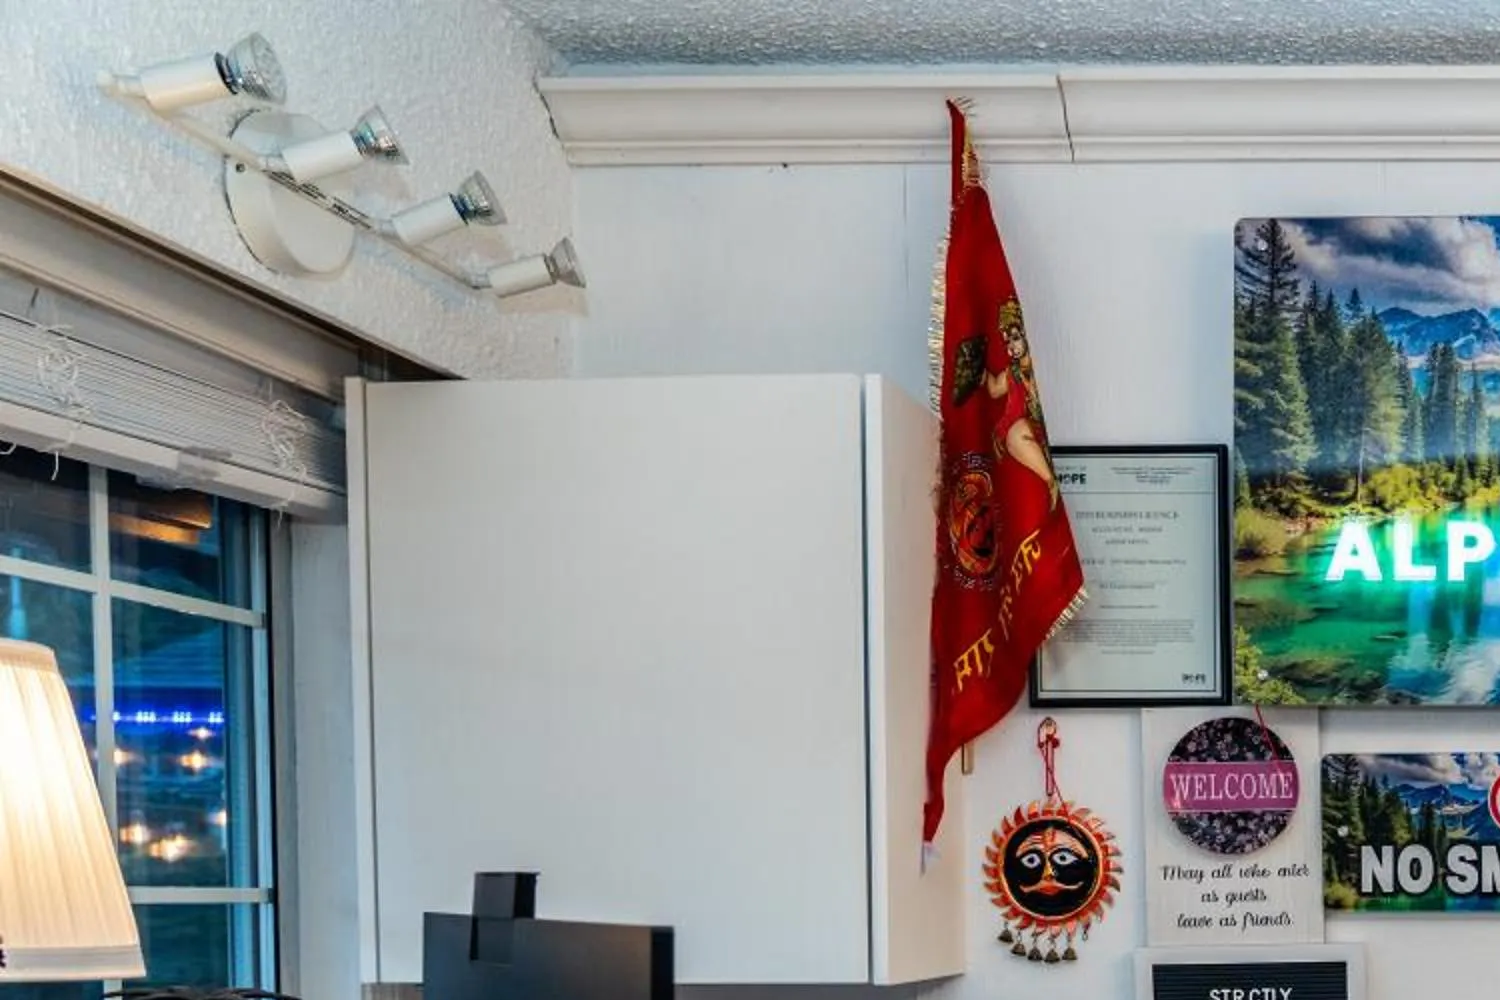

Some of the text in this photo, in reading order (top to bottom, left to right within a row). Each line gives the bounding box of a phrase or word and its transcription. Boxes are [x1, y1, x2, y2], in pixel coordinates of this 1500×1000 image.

[1169, 772, 1294, 801] WELCOME
[1160, 864, 1309, 883] May all who enter
[1361, 843, 1434, 894] NO
[1201, 888, 1267, 908] as guests
[1177, 913, 1213, 929] leave
[1219, 916, 1237, 927] as
